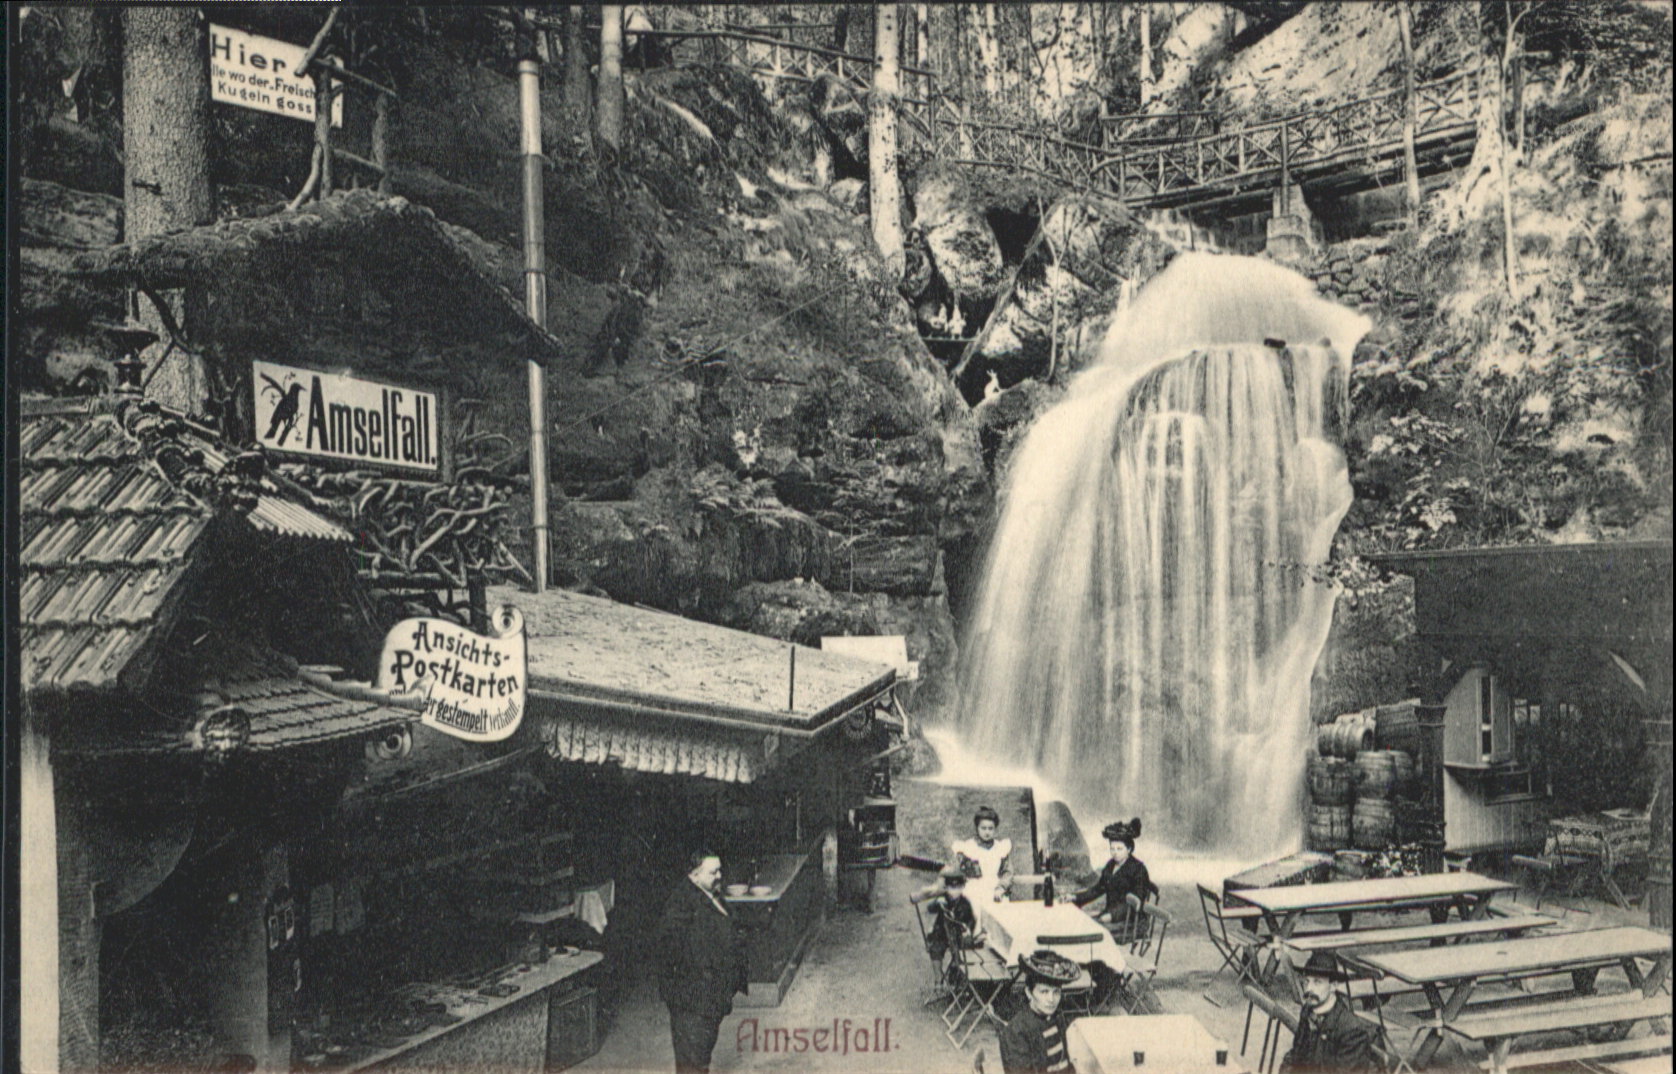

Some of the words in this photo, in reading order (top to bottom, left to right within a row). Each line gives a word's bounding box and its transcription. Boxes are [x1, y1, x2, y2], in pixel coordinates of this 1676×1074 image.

[211, 33, 286, 72] Hier
[217, 80, 270, 104] Kugeln
[228, 71, 246, 83] wo
[248, 75, 270, 90] der
[412, 621, 511, 667] Ansichts-
[390, 650, 519, 699] Postkarten
[436, 698, 488, 733] gestempelt
